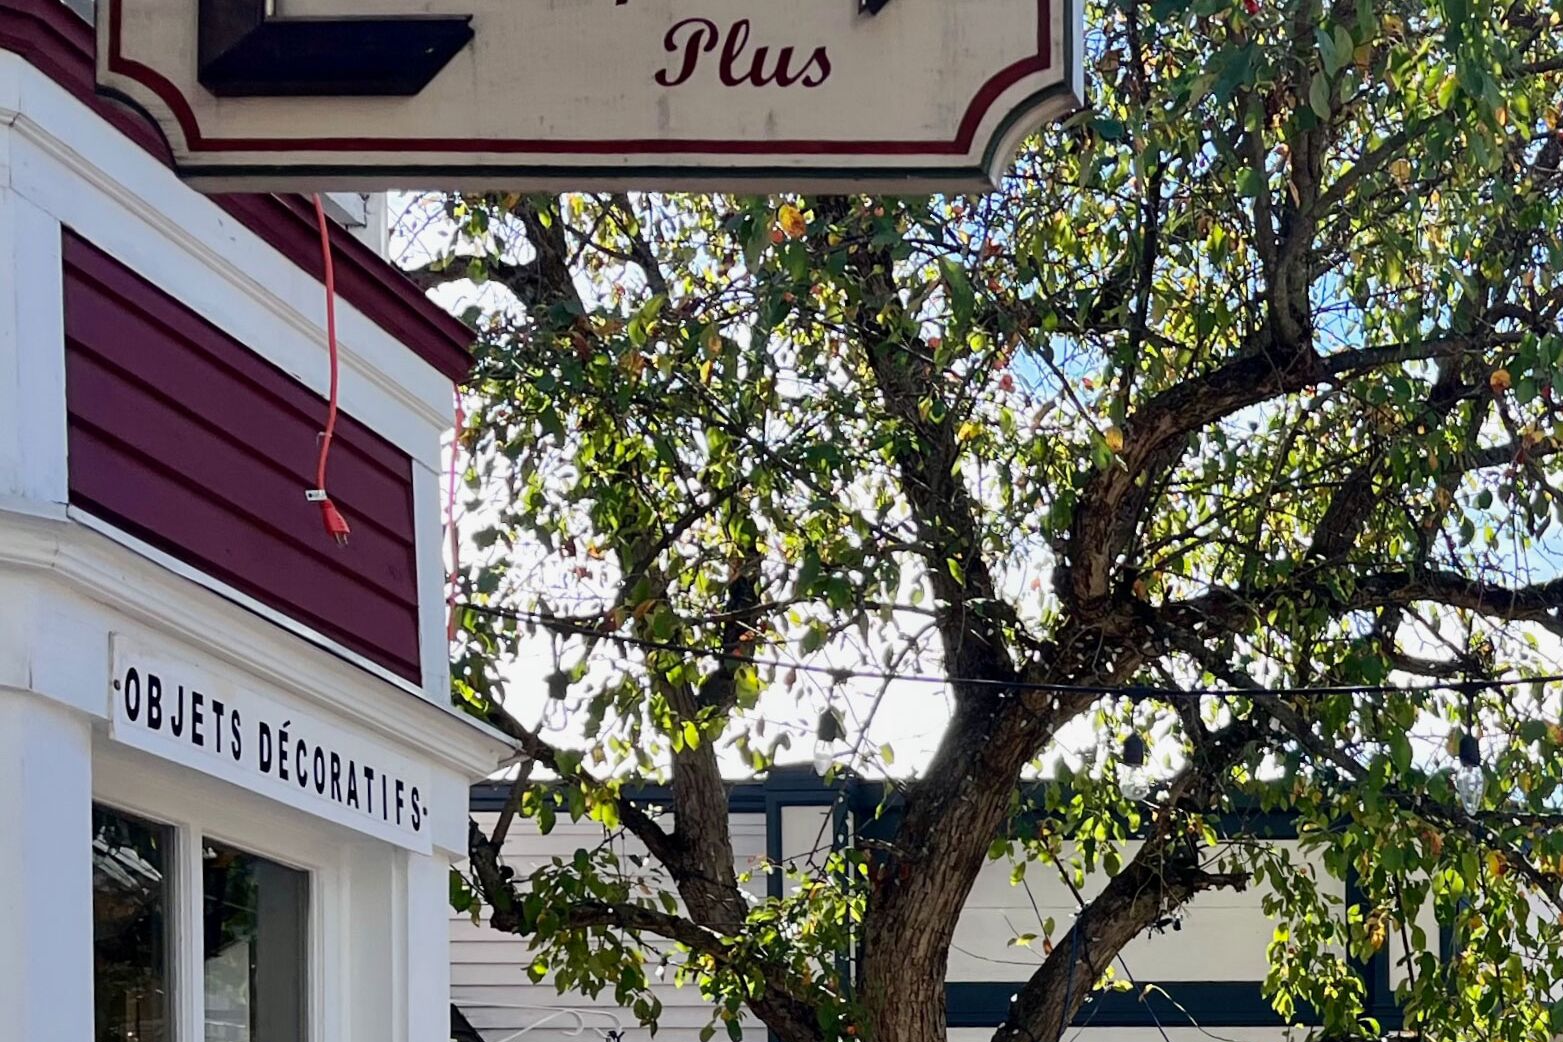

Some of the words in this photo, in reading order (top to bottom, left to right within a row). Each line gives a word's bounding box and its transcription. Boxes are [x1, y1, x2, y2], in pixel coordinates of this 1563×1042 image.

[655, 18, 831, 87] Plus
[125, 667, 242, 761] OBJETS
[260, 720, 421, 832] DÉCORATIFS
